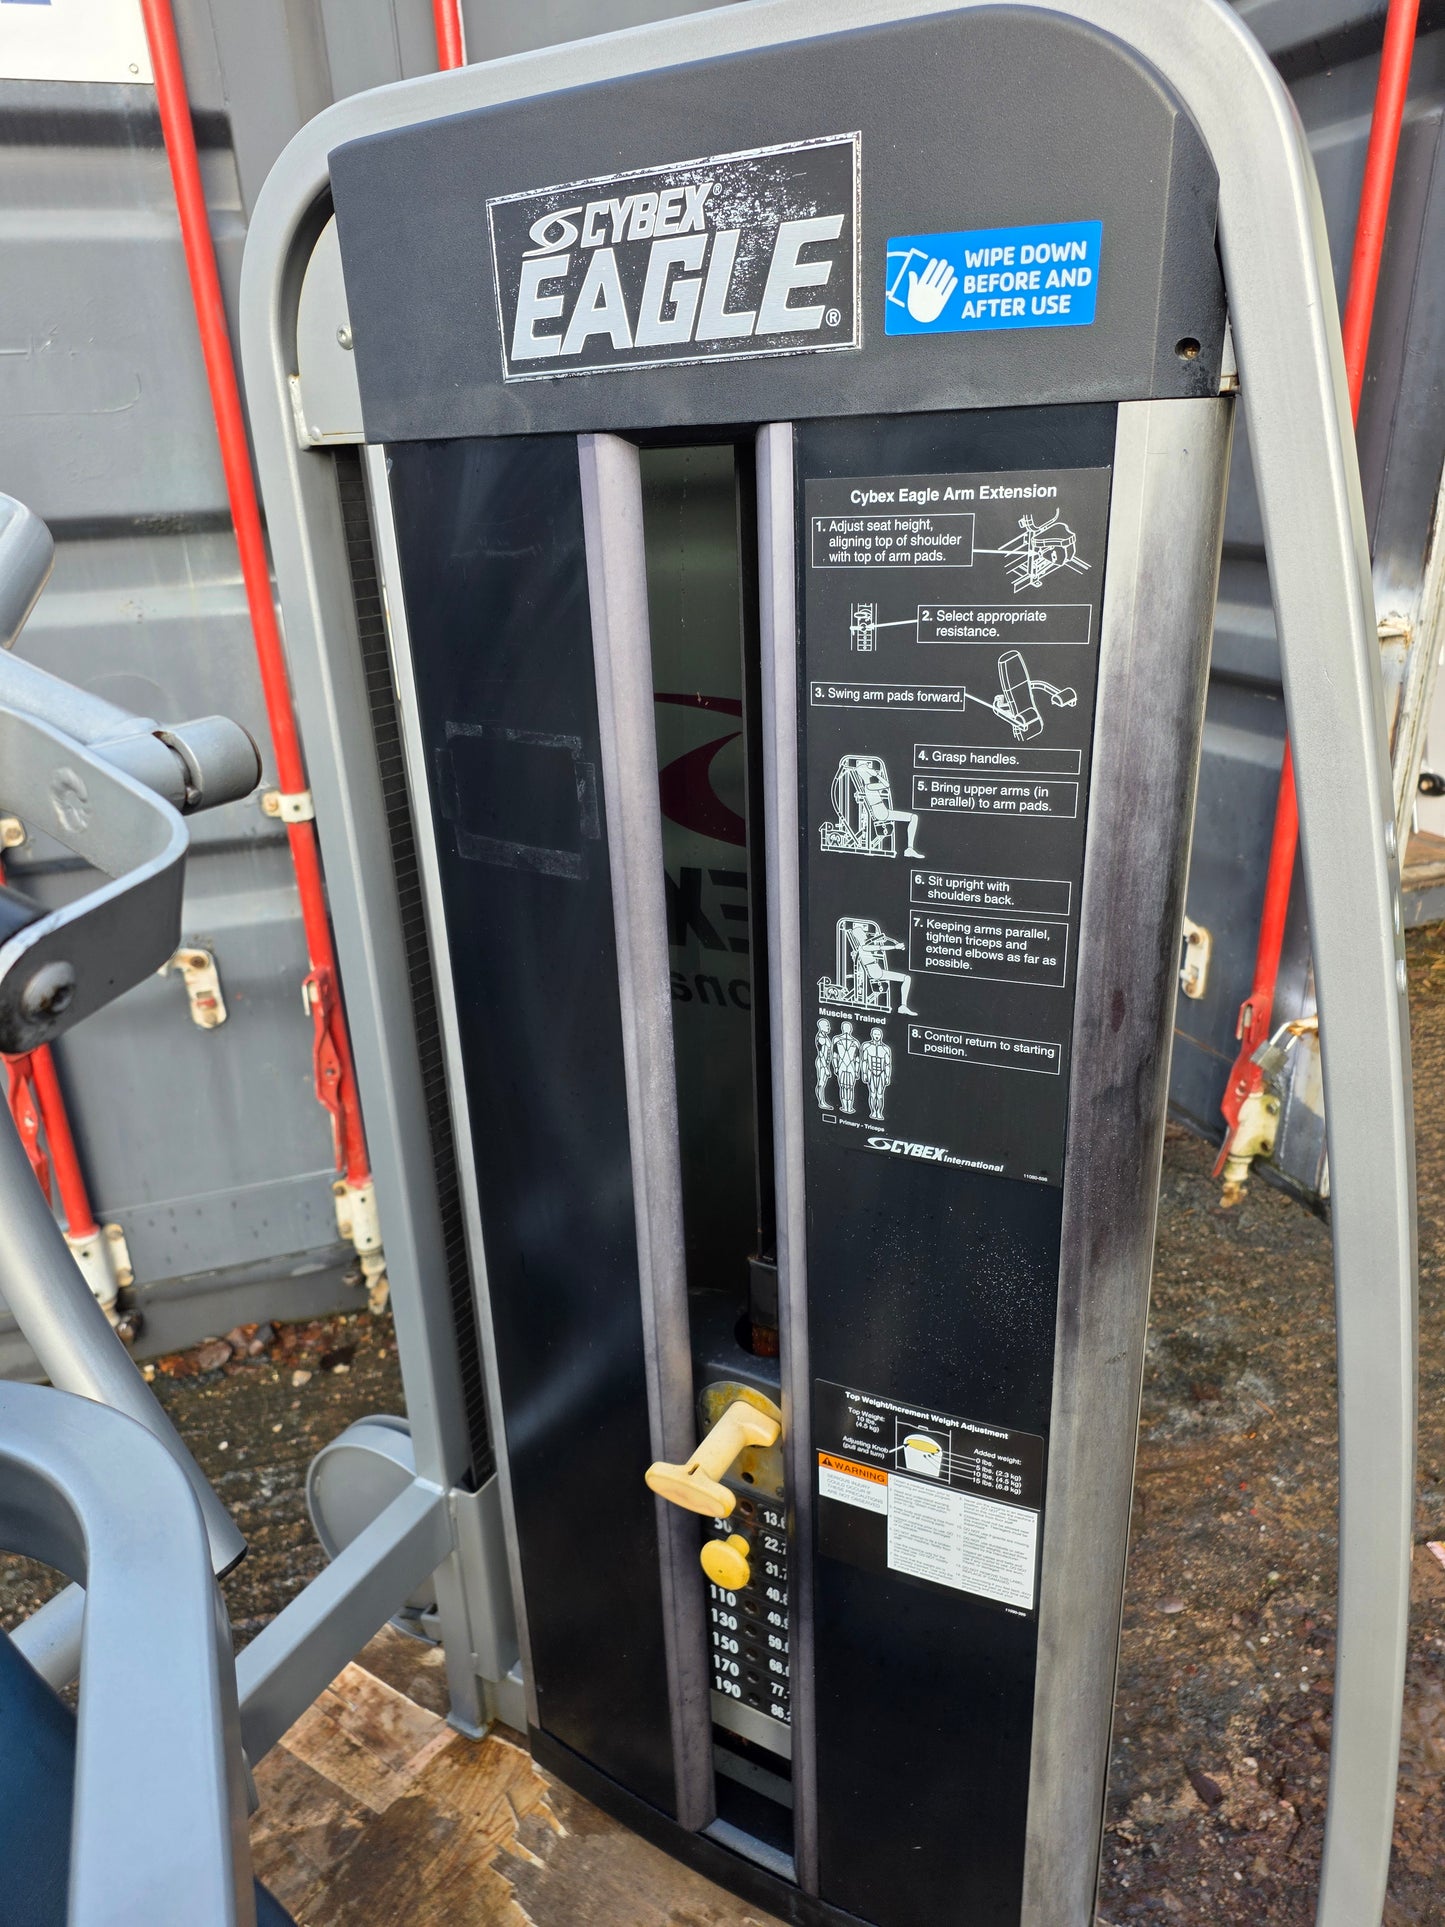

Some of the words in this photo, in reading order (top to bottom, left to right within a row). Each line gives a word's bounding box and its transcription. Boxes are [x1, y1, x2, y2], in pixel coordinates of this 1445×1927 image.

[964, 246, 1016, 269] WIPE
[1020, 240, 1087, 265] DOWN
[963, 270, 1041, 295] BEFORE
[1044, 267, 1092, 289] AND
[961, 297, 1026, 319] AFTER
[1031, 294, 1072, 316] USE
[850, 490, 895, 506] Cybex
[899, 488, 939, 504] Eagle
[943, 488, 975, 500] Arm
[979, 484, 1057, 499] Extension
[816, 521, 826, 532] 1.
[829, 519, 864, 534] Adjust
[867, 520, 891, 531] seat
[894, 518, 934, 533] height,
[829, 536, 872, 550] aligning
[875, 537, 893, 550] top
[896, 535, 908, 546] of
[910, 534, 962, 545] shoulder
[829, 552, 851, 562] with
[854, 552, 872, 565] top
[875, 550, 886, 561] of
[888, 553, 912, 562] arm
[914, 549, 946, 564] pads.
[922, 611, 933, 621] 2.
[936, 610, 974, 622] Select
[977, 611, 1047, 625] appropriate
[936, 626, 1000, 638] resistance.
[815, 688, 825, 698] 3.
[828, 688, 860, 703] Swing
[863, 691, 884, 700] arm
[887, 690, 914, 704] pads
[917, 691, 963, 703] forward.
[918, 751, 929, 761] 4.
[932, 752, 967, 766] Grasp
[970, 753, 1020, 765] handles.
[917, 782, 928, 792] 5.
[931, 782, 961, 796] Bring
[964, 786, 997, 797] upper
[1000, 786, 1030, 797] arms
[1033, 785, 1049, 799] (in
[930, 795, 975, 810] parallel)
[979, 798, 990, 808] to
[993, 800, 1016, 810] arm
[1019, 800, 1052, 814] pads.
[915, 875, 925, 885] 6.
[928, 875, 943, 886] Sit
[945, 877, 984, 892] upright
[987, 881, 1010, 892] with
[927, 889, 981, 902] shoulders
[984, 894, 1015, 906] back.
[914, 918, 924, 928] 7.
[926, 919, 971, 935] Keeping
[974, 925, 1002, 937] arms
[1005, 927, 1050, 942] parallel,
[926, 931, 963, 945] tighten
[965, 935, 1003, 949] triceps
[1005, 939, 1027, 951] and
[925, 945, 963, 957] extend
[965, 947, 1004, 961] elbows
[1006, 953, 1021, 963] as
[1023, 953, 1040, 964] far
[1042, 956, 1057, 966] as
[925, 957, 973, 971] possible.
[818, 1007, 853, 1019] Muscles
[854, 1013, 886, 1025] Trained
[911, 1028, 922, 1039] 8.
[924, 1030, 963, 1045] Control
[965, 1037, 997, 1049] return
[1000, 1041, 1011, 1050] to
[1013, 1042, 1055, 1059] starting
[924, 1042, 968, 1057] position.
[839, 1118, 861, 1128] Primary
[864, 1123, 885, 1133] Triceps
[943, 1155, 1005, 1172] International
[844, 1391, 861, 1402] Top
[861, 1395, 930, 1420] Weight/Increment
[930, 1414, 960, 1427] Weight
[960, 1422, 1009, 1440] Adjustment
[848, 1406, 861, 1416] Top
[842, 1435, 871, 1450] Adjusting
[871, 1443, 889, 1454] Knob
[857, 1445, 870, 1454] and
[973, 1448, 996, 1459] Added
[997, 1454, 1022, 1466] weight:
[981, 1458, 995, 1467] lbs.
[834, 1461, 885, 1483] WARNING
[981, 1466, 995, 1475] lbs.
[1010, 1473, 1022, 1482] kg)
[981, 1472, 995, 1481] lbs.
[1010, 1480, 1022, 1489] kg)
[981, 1479, 995, 1488] lbs.
[1010, 1486, 1022, 1495] kg)
[710, 1583, 737, 1607] 110
[711, 1607, 738, 1631] 130
[712, 1631, 739, 1654] 150
[713, 1654, 740, 1677] 170
[715, 1675, 741, 1699] 190
[770, 1681, 791, 1700] 77.
